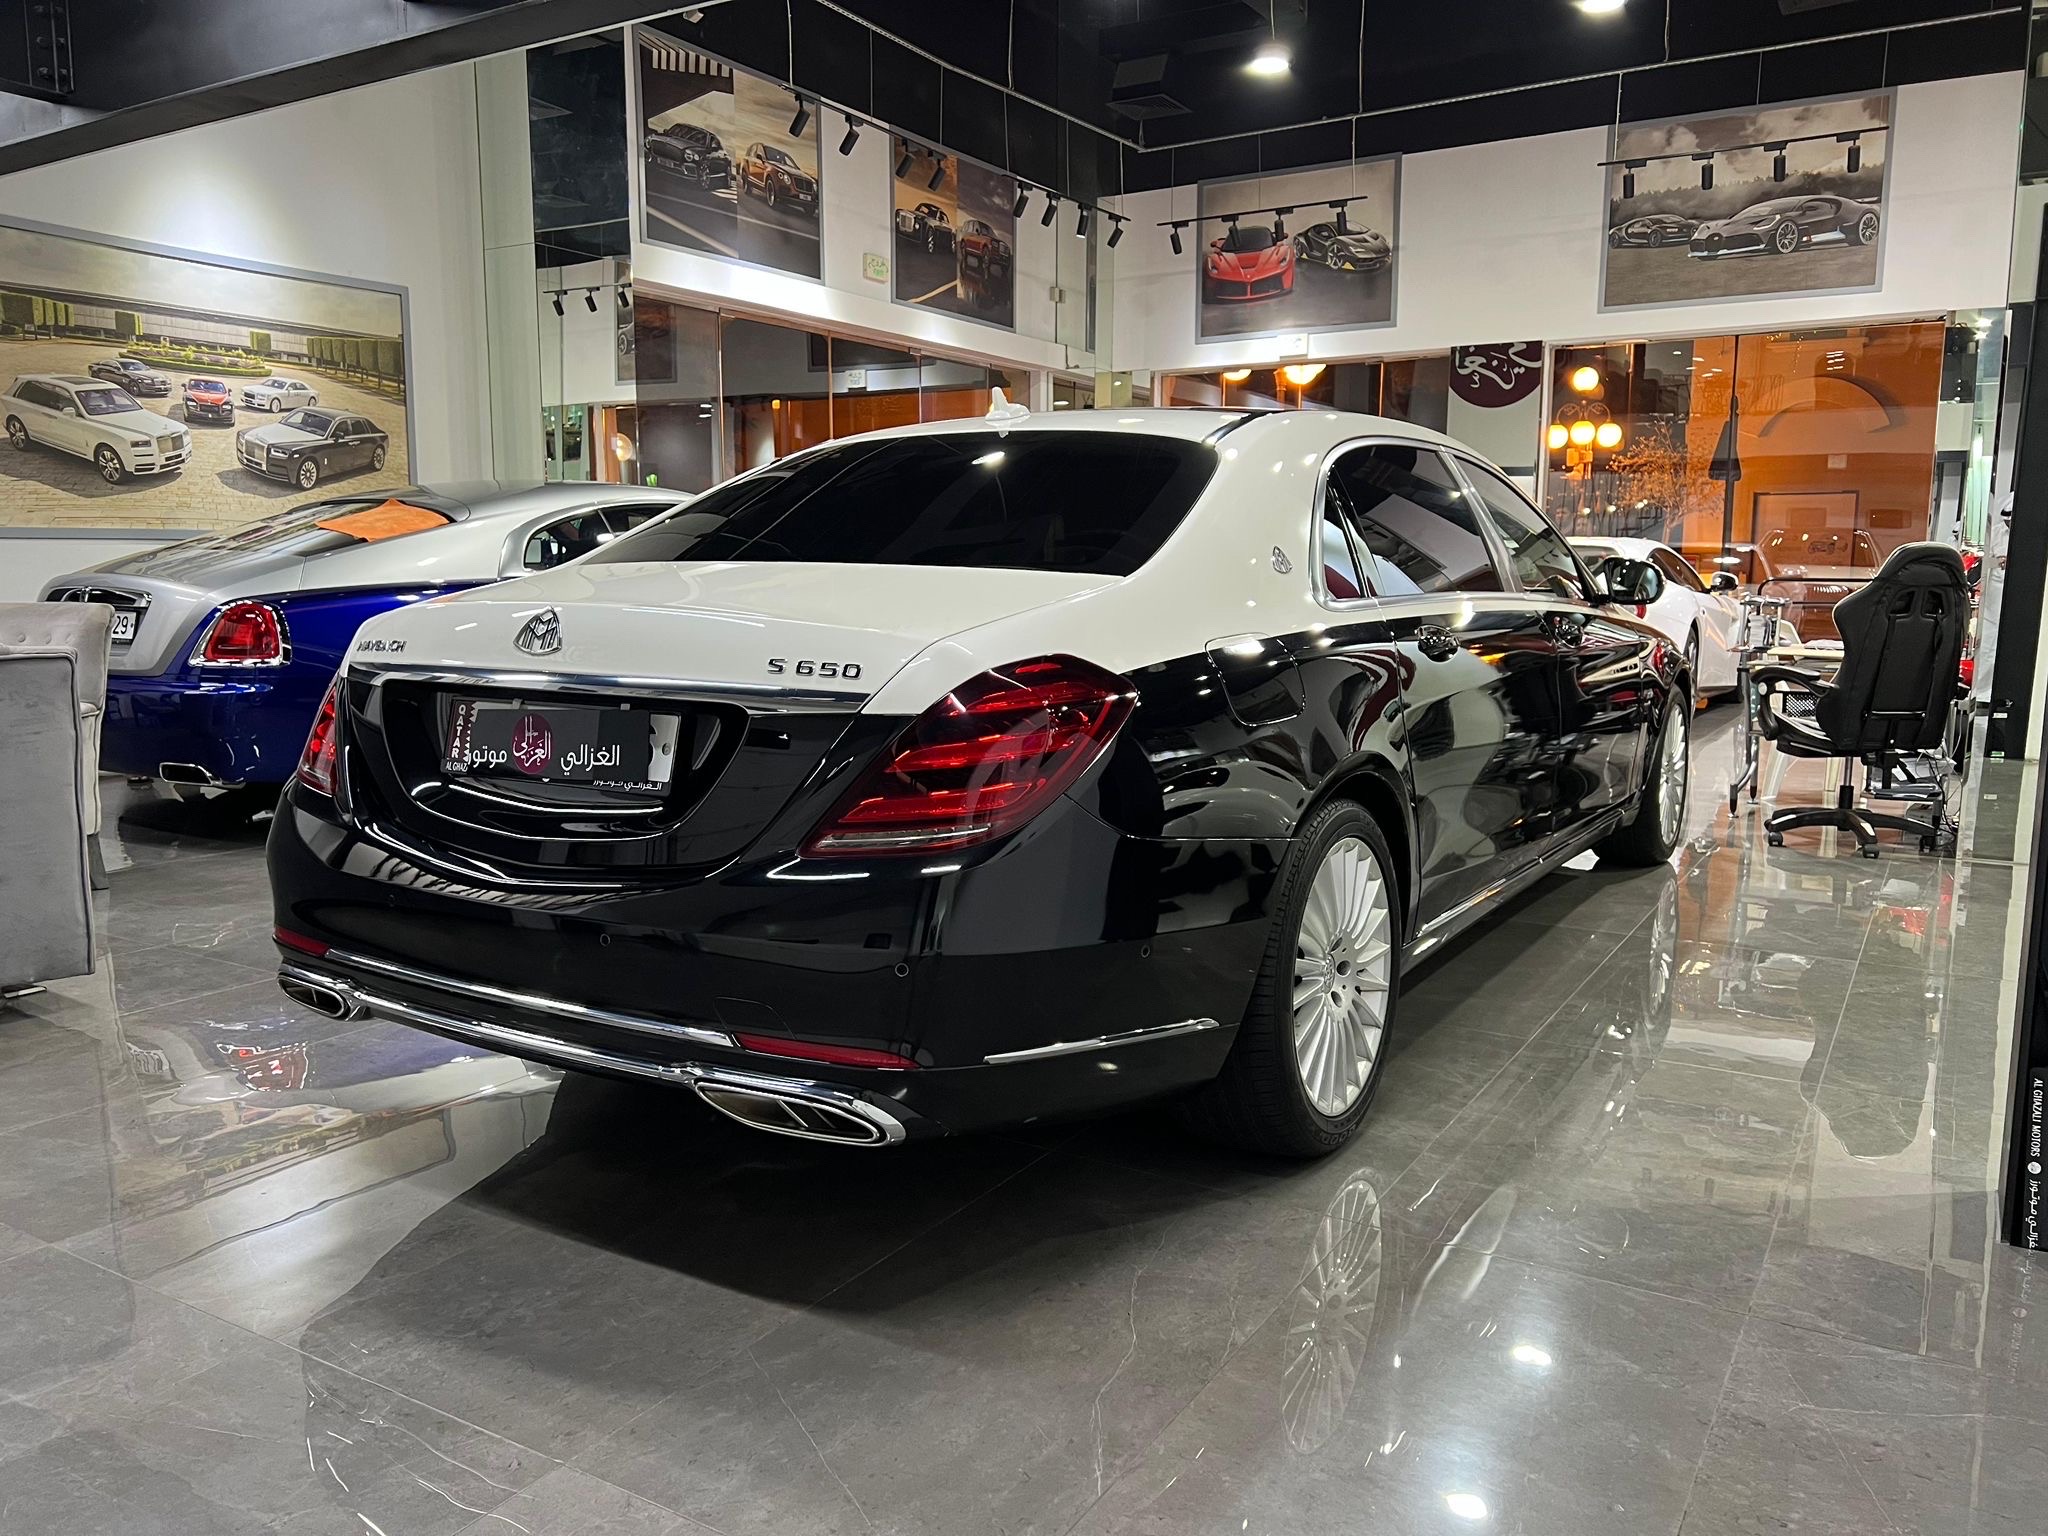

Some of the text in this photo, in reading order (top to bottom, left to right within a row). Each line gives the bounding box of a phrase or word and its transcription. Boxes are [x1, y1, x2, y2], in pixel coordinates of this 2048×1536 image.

[767, 658, 863, 680] S 650
[452, 704, 466, 759] QATAR
[452, 762, 469, 773] GHAZ
[2030, 1078, 2044, 1157] AL GHAZALI MOTORS
